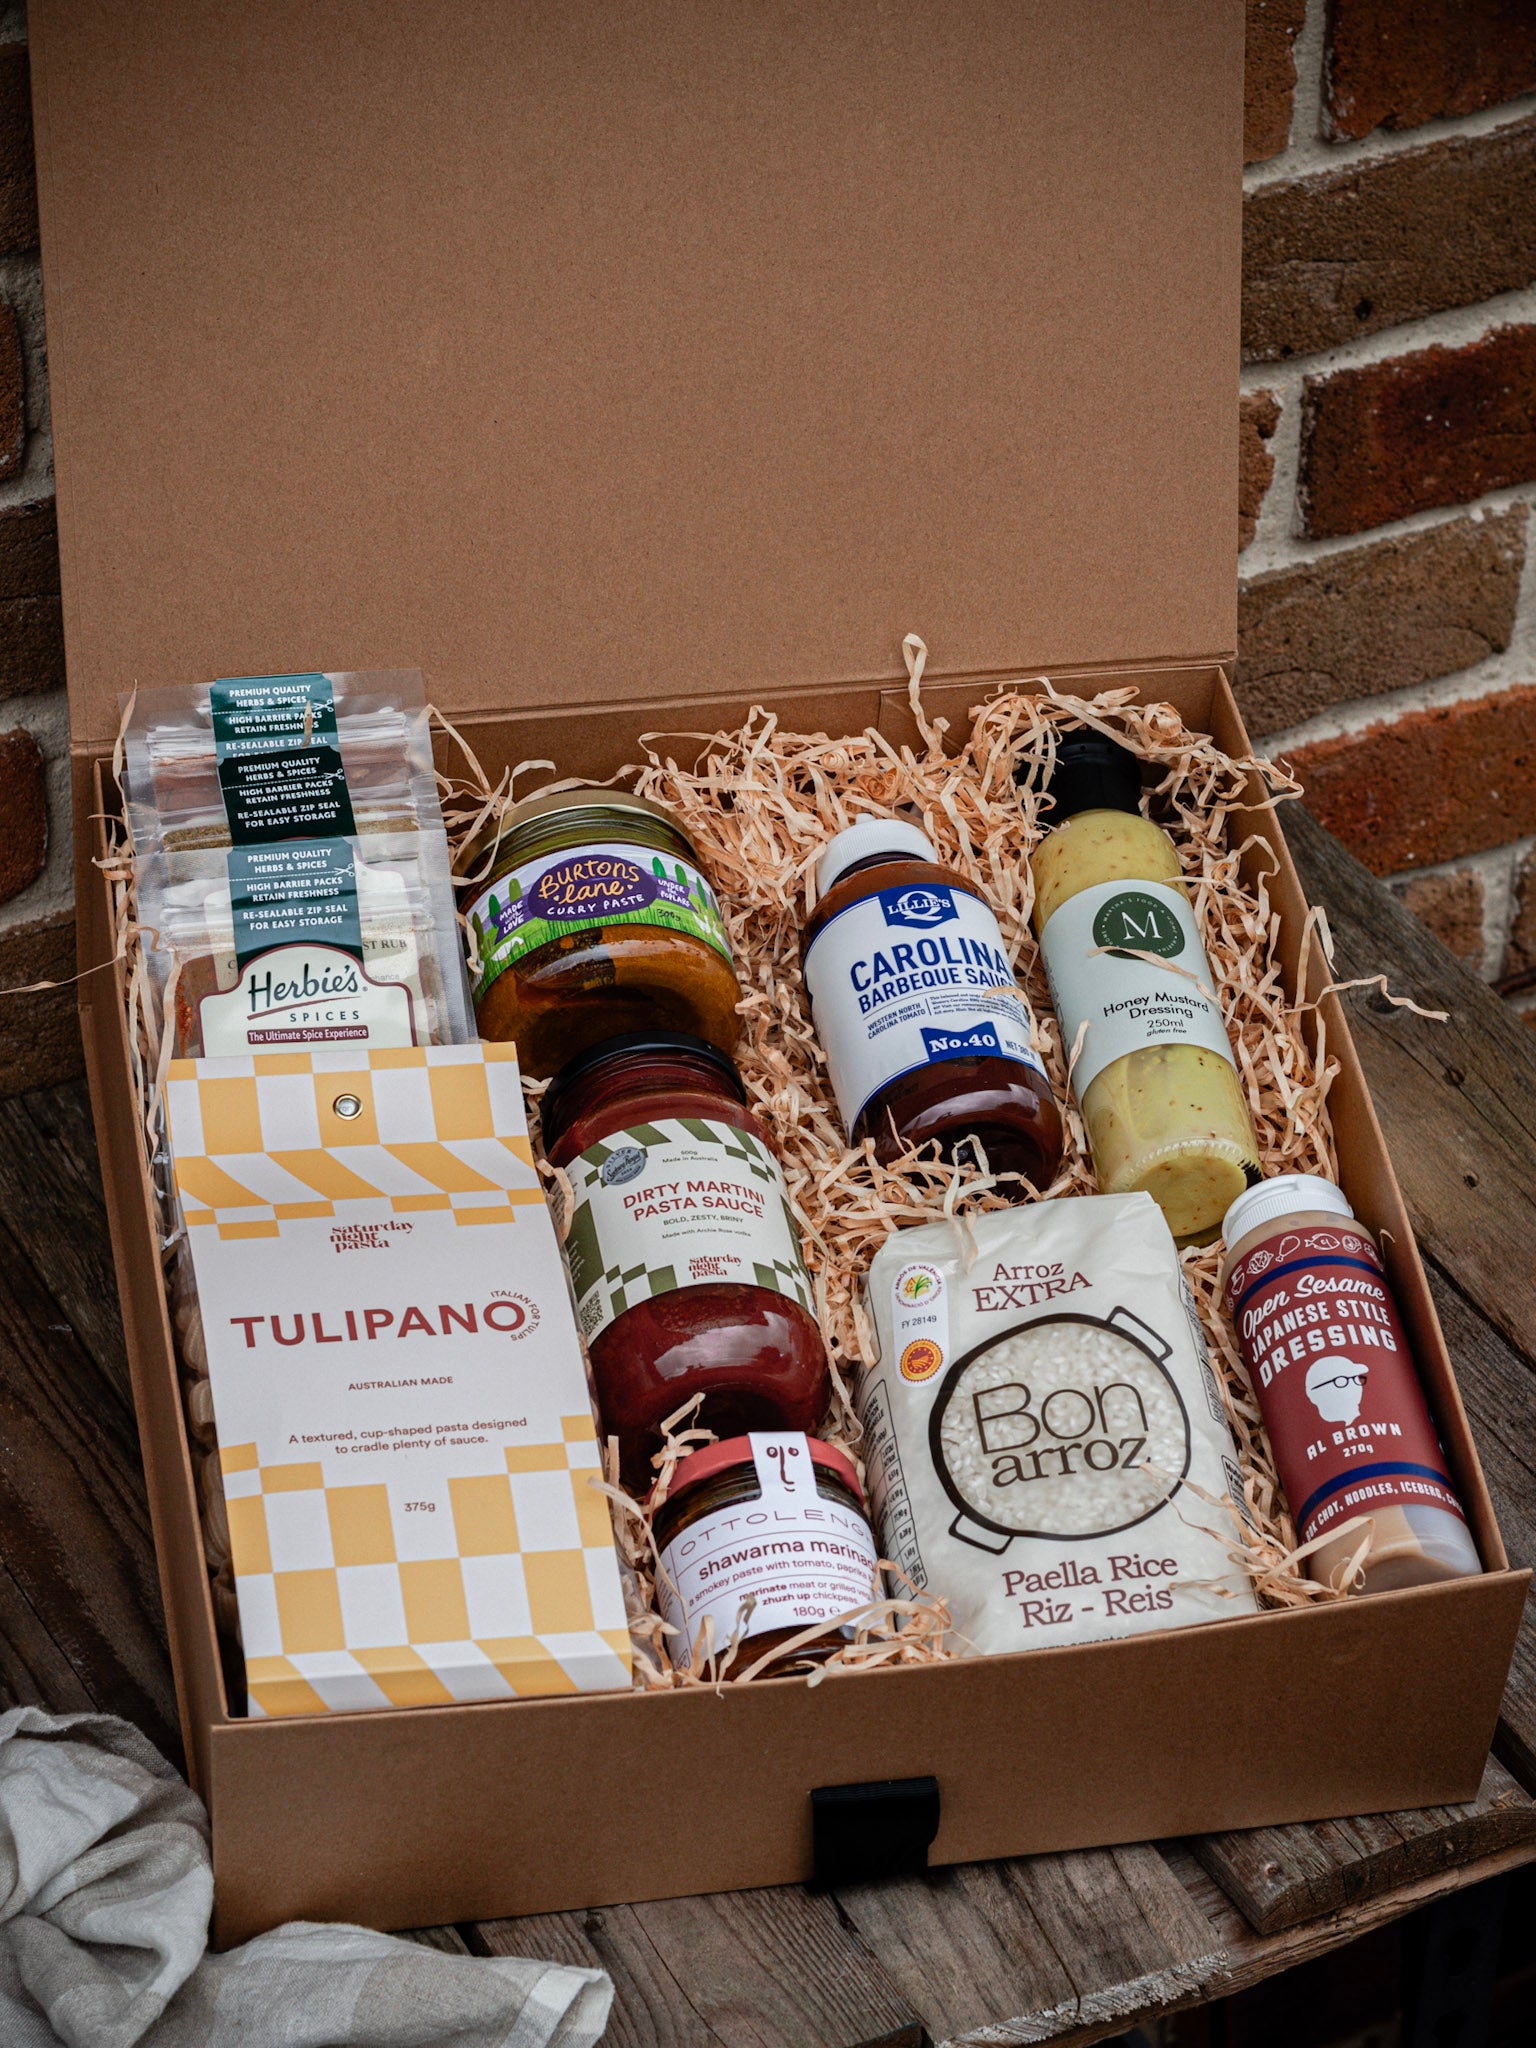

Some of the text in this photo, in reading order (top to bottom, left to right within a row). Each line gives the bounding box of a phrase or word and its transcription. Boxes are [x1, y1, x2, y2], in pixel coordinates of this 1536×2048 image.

[229, 685, 312, 697] PREMIUM QUALITY
[236, 698, 264, 707] HERBS
[277, 696, 307, 704] SPICES
[228, 711, 322, 725] HIGH BARRIER PAKS
[235, 721, 319, 733] RETAIN FRESHNSS
[225, 738, 302, 751] RE-SEALABLE ZIP
[238, 757, 320, 773] PREMIUM QUALITY
[245, 772, 274, 781] HERBS
[287, 767, 317, 777] SPICES
[239, 779, 334, 797] HIGH BARRIER PACKS
[246, 789, 331, 805] RETAIN FRESHNESS
[238, 801, 341, 819] RE-SEALABLE ZIP SEAL
[245, 811, 337, 828] FOR EASY STORAGE
[247, 849, 332, 863] PREMIUM QUALITY
[255, 860, 328, 873] HERBS & SPICES
[247, 877, 343, 892] HIGH BARRIER PACKS
[658, 879, 685, 893] UNDER
[252, 888, 339, 902] RETAIN FRESHNESS
[243, 904, 348, 920] RE-SEALABLE ZIP SEAL
[500, 900, 523, 921] MADE
[547, 893, 645, 916] CURRY PASTE
[887, 898, 951, 915] LILLIE'S
[250, 916, 343, 930] FOR EASY STORAGE
[504, 914, 524, 934] LOVE
[1122, 911, 1164, 940] M
[381, 939, 408, 949] RUB
[850, 937, 1012, 992] CAROLINA
[247, 963, 358, 1012] Herbie's
[858, 967, 962, 1014] BARBEQUE
[1103, 991, 1210, 1018] Honey Mustard
[1129, 1004, 1193, 1019] Dressing
[289, 1010, 360, 1022] SPICES
[868, 1011, 898, 1031] WESTERN
[898, 1003, 922, 1015] NORTH
[868, 1018, 899, 1040] CAROLINA
[899, 1009, 926, 1023] TOMATO
[1146, 1018, 1184, 1029] 250ml
[249, 1027, 367, 1041] The Ultimate Spice Experience
[1146, 1027, 1171, 1037] gluten
[928, 1034, 996, 1052] No.40
[623, 1180, 765, 1209] DIRTY MARTINI
[633, 1196, 764, 1221] PASTA SAUCE
[331, 1220, 415, 1234] saturday
[663, 1214, 743, 1226] BOLD, ZESTY, BRINY
[330, 1231, 378, 1244] night
[662, 1231, 680, 1239] Made
[335, 1239, 390, 1253] pasta
[689, 1254, 742, 1267] saturday
[692, 1269, 728, 1280] pasta
[992, 1262, 1064, 1282] Arroz
[972, 1271, 1093, 1312] EXTRA
[1243, 1274, 1386, 1339] Open Sesame
[229, 1300, 525, 1348] TULIPANO
[490, 1290, 541, 1341] ITALIAN FOR TULIPS
[901, 1315, 937, 1329] FY 28149
[1252, 1299, 1392, 1364] JAPANESE STYLE
[1259, 1324, 1398, 1389] DRESSING
[348, 1376, 454, 1391] AUSTRALIAN MADE
[972, 1381, 1149, 1454] Bon
[288, 1417, 528, 1445] A textured, cup-shaped pasta designed
[335, 1435, 489, 1455] to cradle plenty of sauce.
[1306, 1422, 1402, 1461] AL BROWN
[1342, 1444, 1374, 1458] 270g
[992, 1436, 1149, 1488] arroz
[404, 1501, 437, 1513] 375g
[1305, 1481, 1446, 1542] BOK CHOY, NOODLES, ICEBERG,
[699, 1540, 805, 1580] shawarma
[689, 1559, 868, 1608] a smokey paste with tomato, paprika
[1002, 1552, 1179, 1598] Paella Rice
[739, 1583, 787, 1601] marinate
[789, 1580, 815, 1590] meat
[829, 1580, 856, 1594] grilled
[762, 1592, 795, 1606] zhuzh
[797, 1592, 811, 1602] up
[792, 1606, 825, 1618] 180g
[1019, 1584, 1175, 1629] Riz Reis
